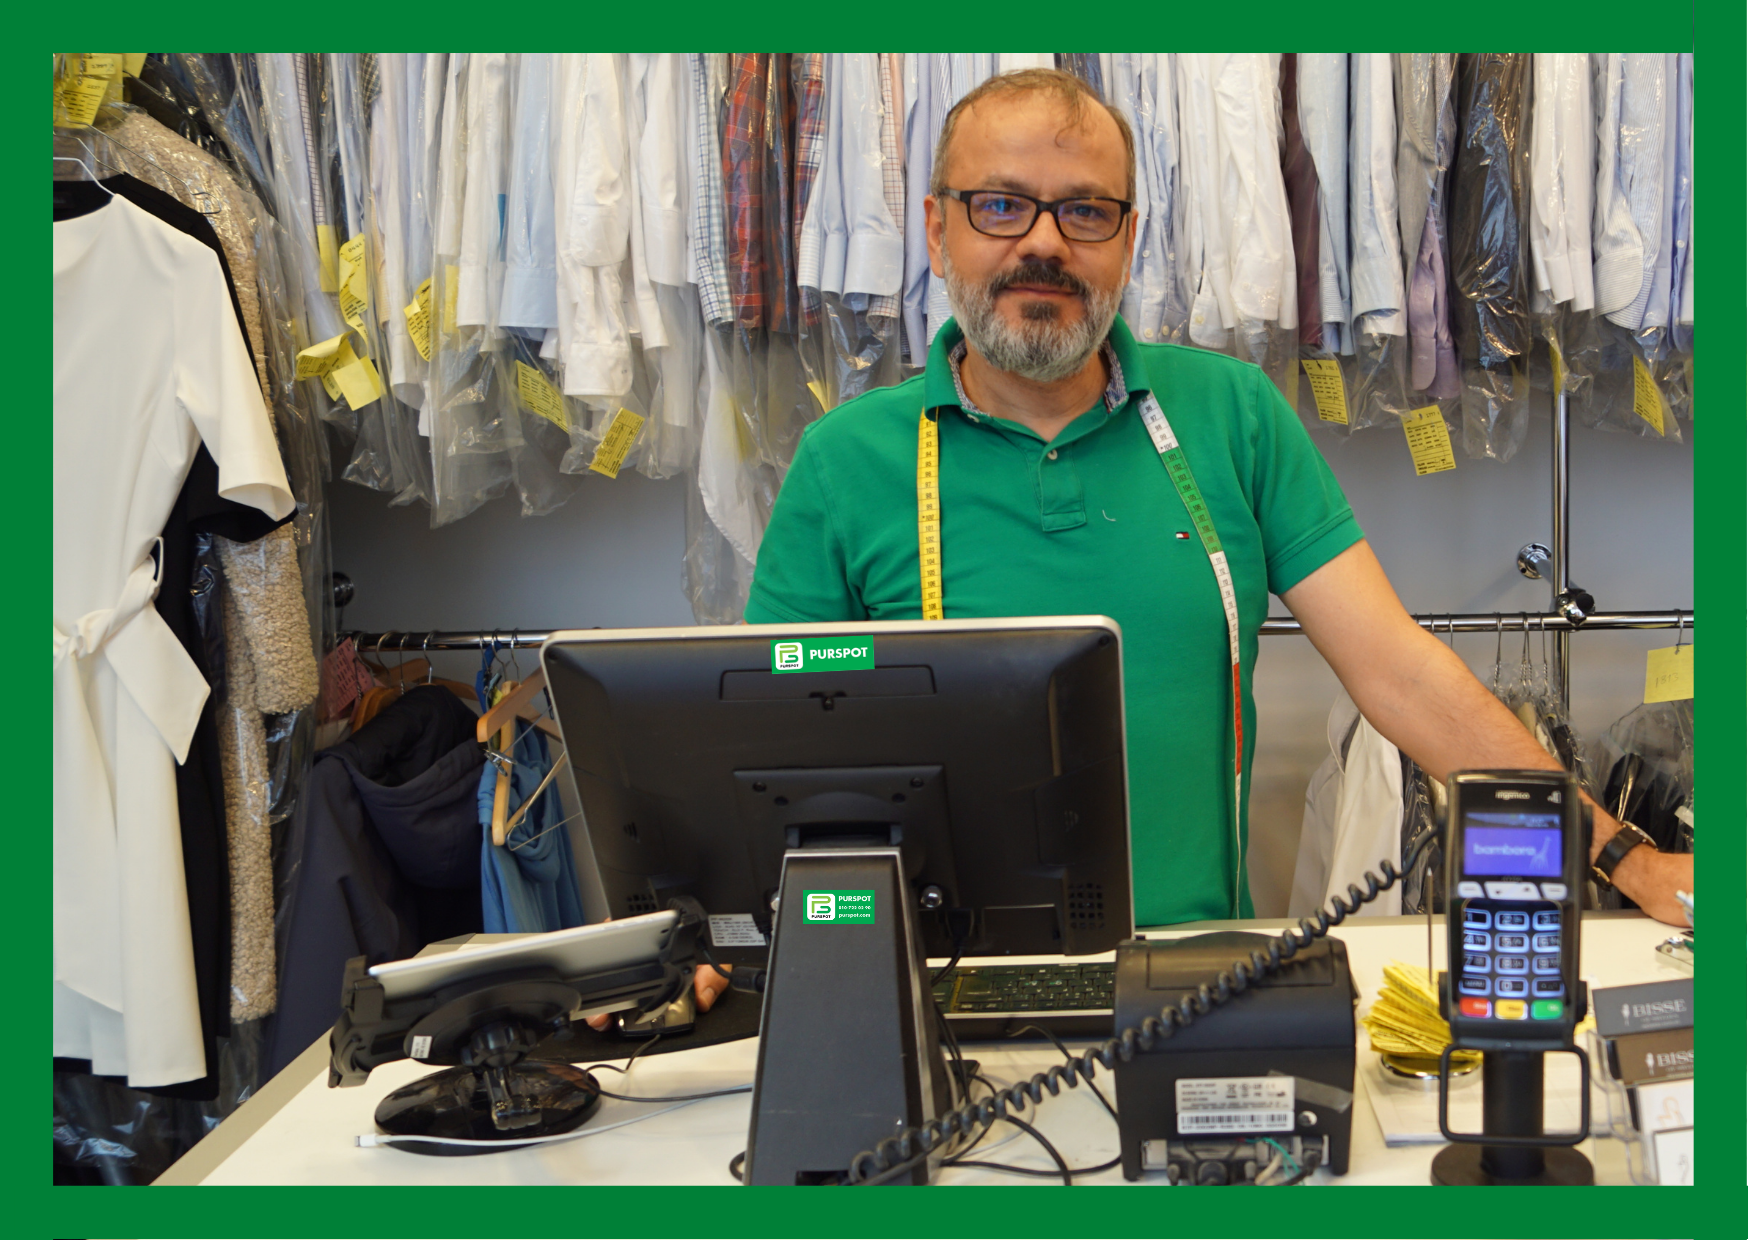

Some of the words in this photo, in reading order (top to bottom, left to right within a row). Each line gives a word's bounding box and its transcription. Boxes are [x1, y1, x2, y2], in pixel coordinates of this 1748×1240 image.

[1163, 442, 1173, 451] 100
[1168, 453, 1177, 461] 101
[1173, 463, 1182, 472] 102
[1632, 998, 1687, 1017] BISSE
